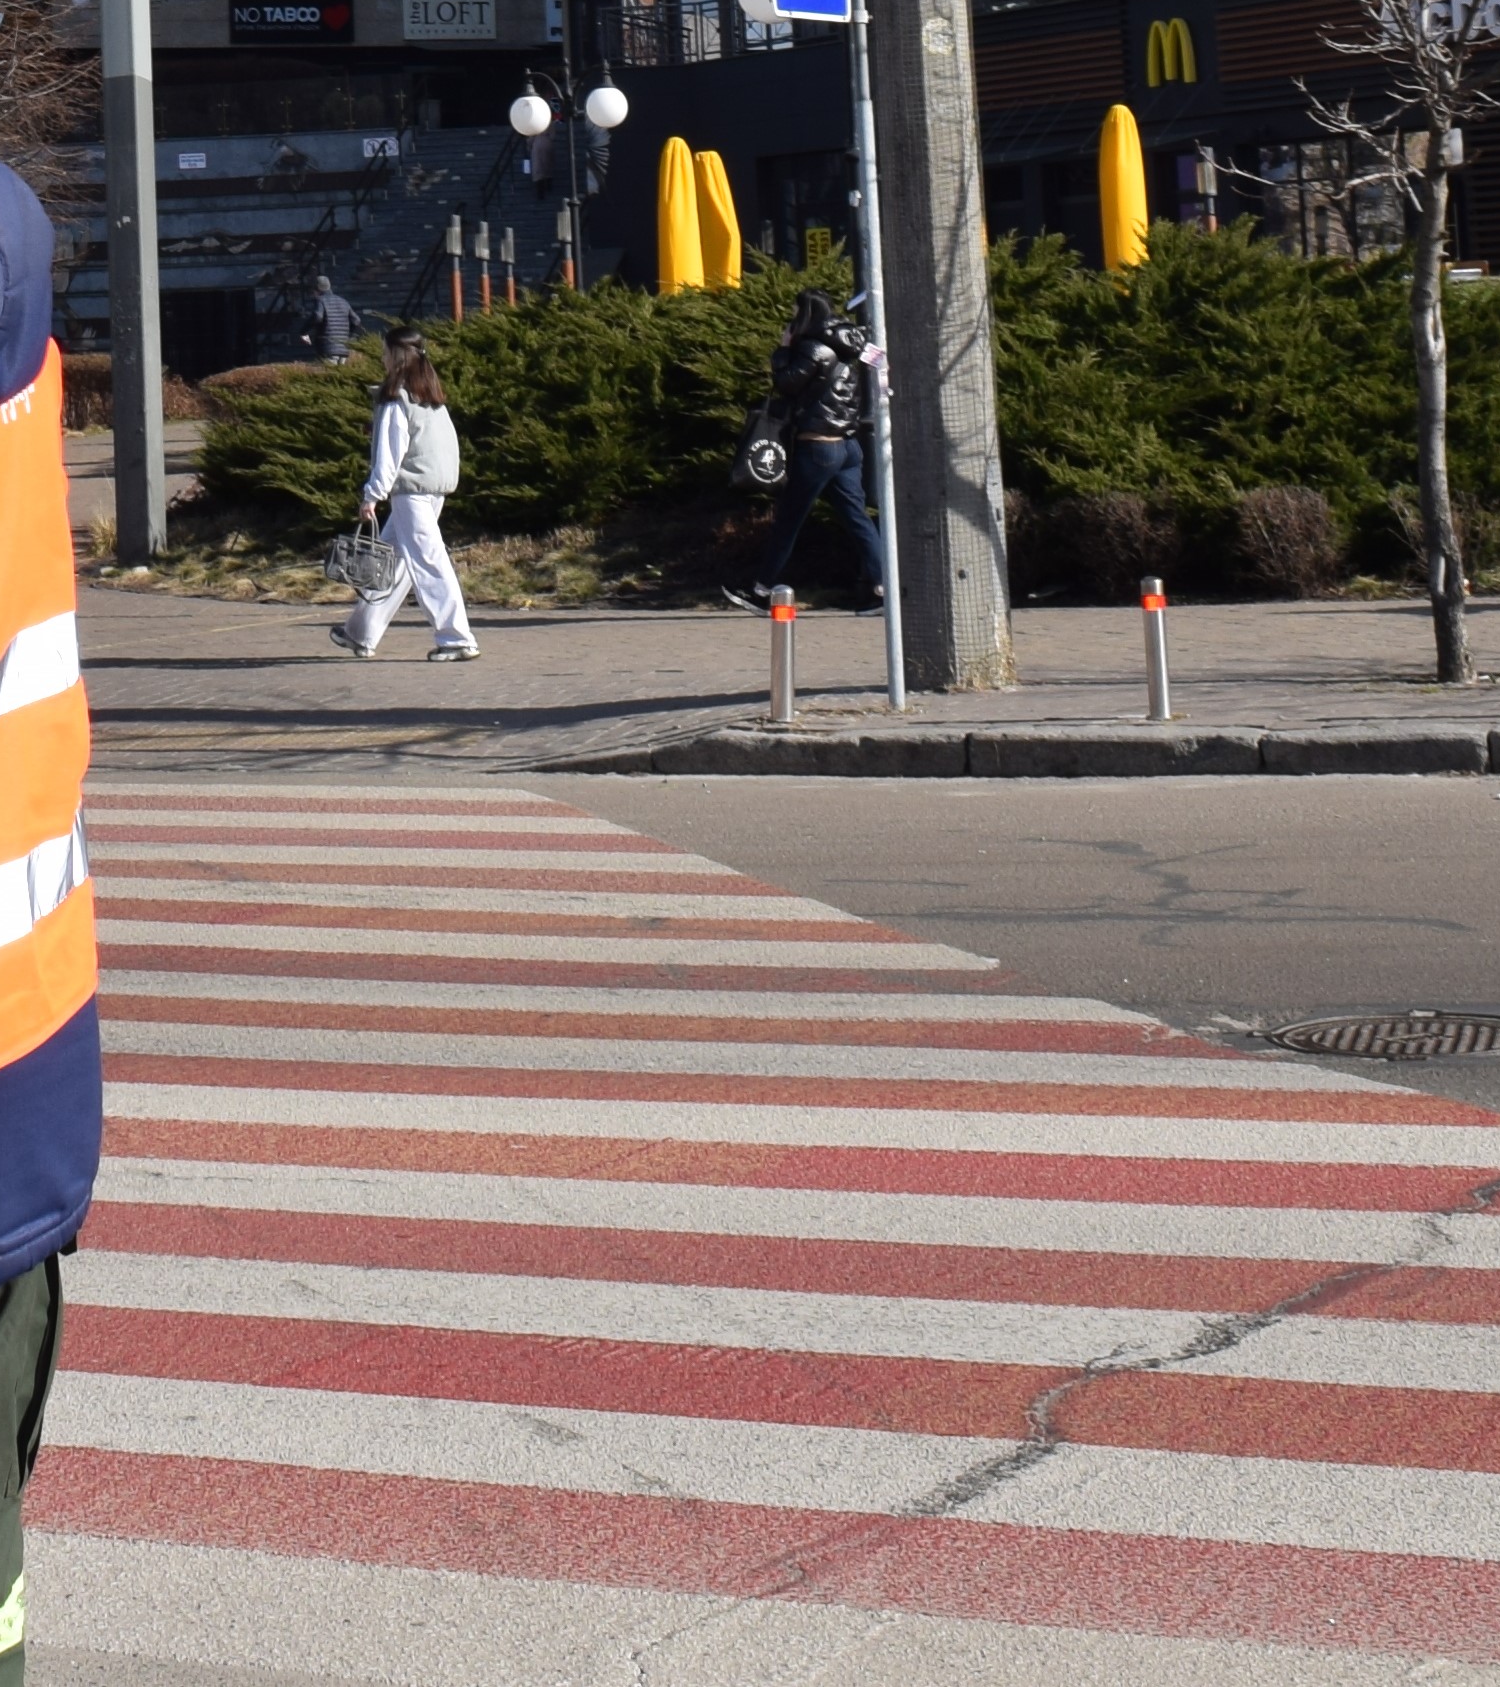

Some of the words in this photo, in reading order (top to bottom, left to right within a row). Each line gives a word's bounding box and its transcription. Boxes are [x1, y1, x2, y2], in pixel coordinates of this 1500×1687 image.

[234, 7, 260, 23] NO
[263, 6, 320, 23] TABOO
[410, 2, 421, 25] the
[422, 1, 490, 25] LOFT
